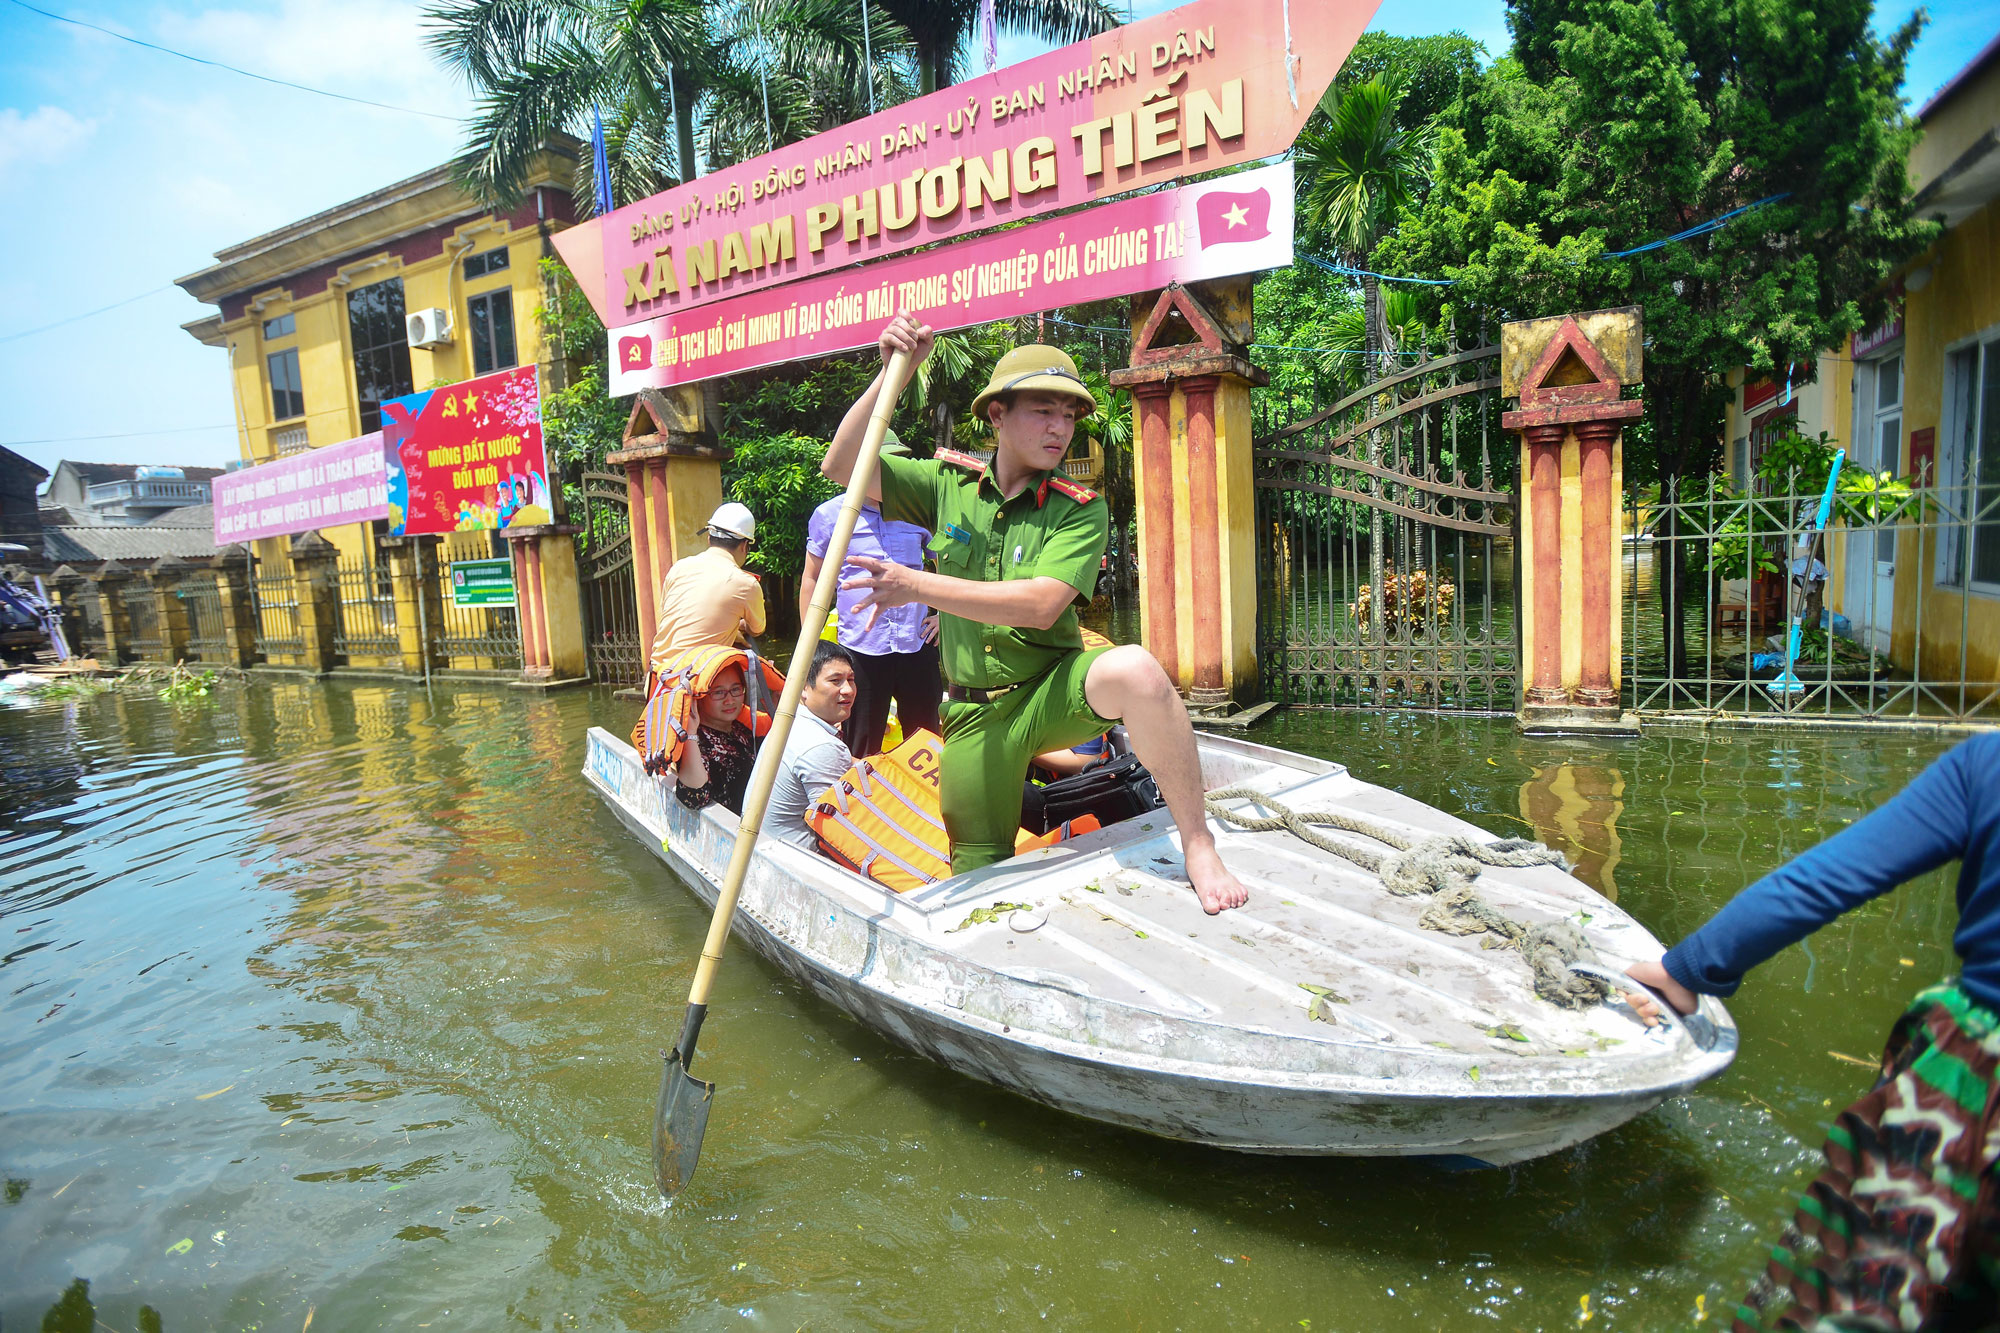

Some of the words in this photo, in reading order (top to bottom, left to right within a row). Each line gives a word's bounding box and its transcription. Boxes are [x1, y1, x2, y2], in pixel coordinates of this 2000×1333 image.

[630, 212, 673, 241] ĐẢNG
[680, 194, 702, 223] UỶ
[714, 182, 745, 212] HỘI
[752, 165, 806, 200] ĐỒNG
[814, 141, 872, 178] NHÂN
[880, 122, 927, 156] DÂN
[947, 96, 981, 133] UỶ
[991, 81, 1045, 120] BAN
[1057, 50, 1136, 99] NHÂN
[1151, 25, 1216, 69] DÂN
[621, 245, 679, 307] XÃ
[685, 214, 795, 288] NAM
[806, 136, 1059, 253] PHƯƠNG
[1071, 70, 1244, 176] TIẾN
[657, 326, 679, 368] CHỦ
[680, 329, 705, 368] TỊCH
[707, 316, 724, 357] HỒ
[726, 314, 746, 352] CHÍ
[747, 312, 781, 347] MINH
[783, 302, 798, 339] VĨ
[799, 302, 822, 340] ĐẠI
[825, 286, 863, 330] SỐNG
[866, 281, 895, 321] MÃI
[898, 273, 948, 314] TRONG
[951, 264, 976, 308] SỰ
[977, 249, 1039, 298] NGHIỆP
[1043, 232, 1079, 284] CỦA
[1084, 226, 1148, 274] CHÚNG
[1153, 219, 1185, 260] TA!
[427, 445, 461, 468] MỪNG
[462, 436, 485, 463] ĐẤT
[487, 433, 521, 459] NƯỚC
[452, 463, 473, 489] ĐỔI
[474, 463, 498, 487] MỚI
[908, 748, 939, 787] CA
